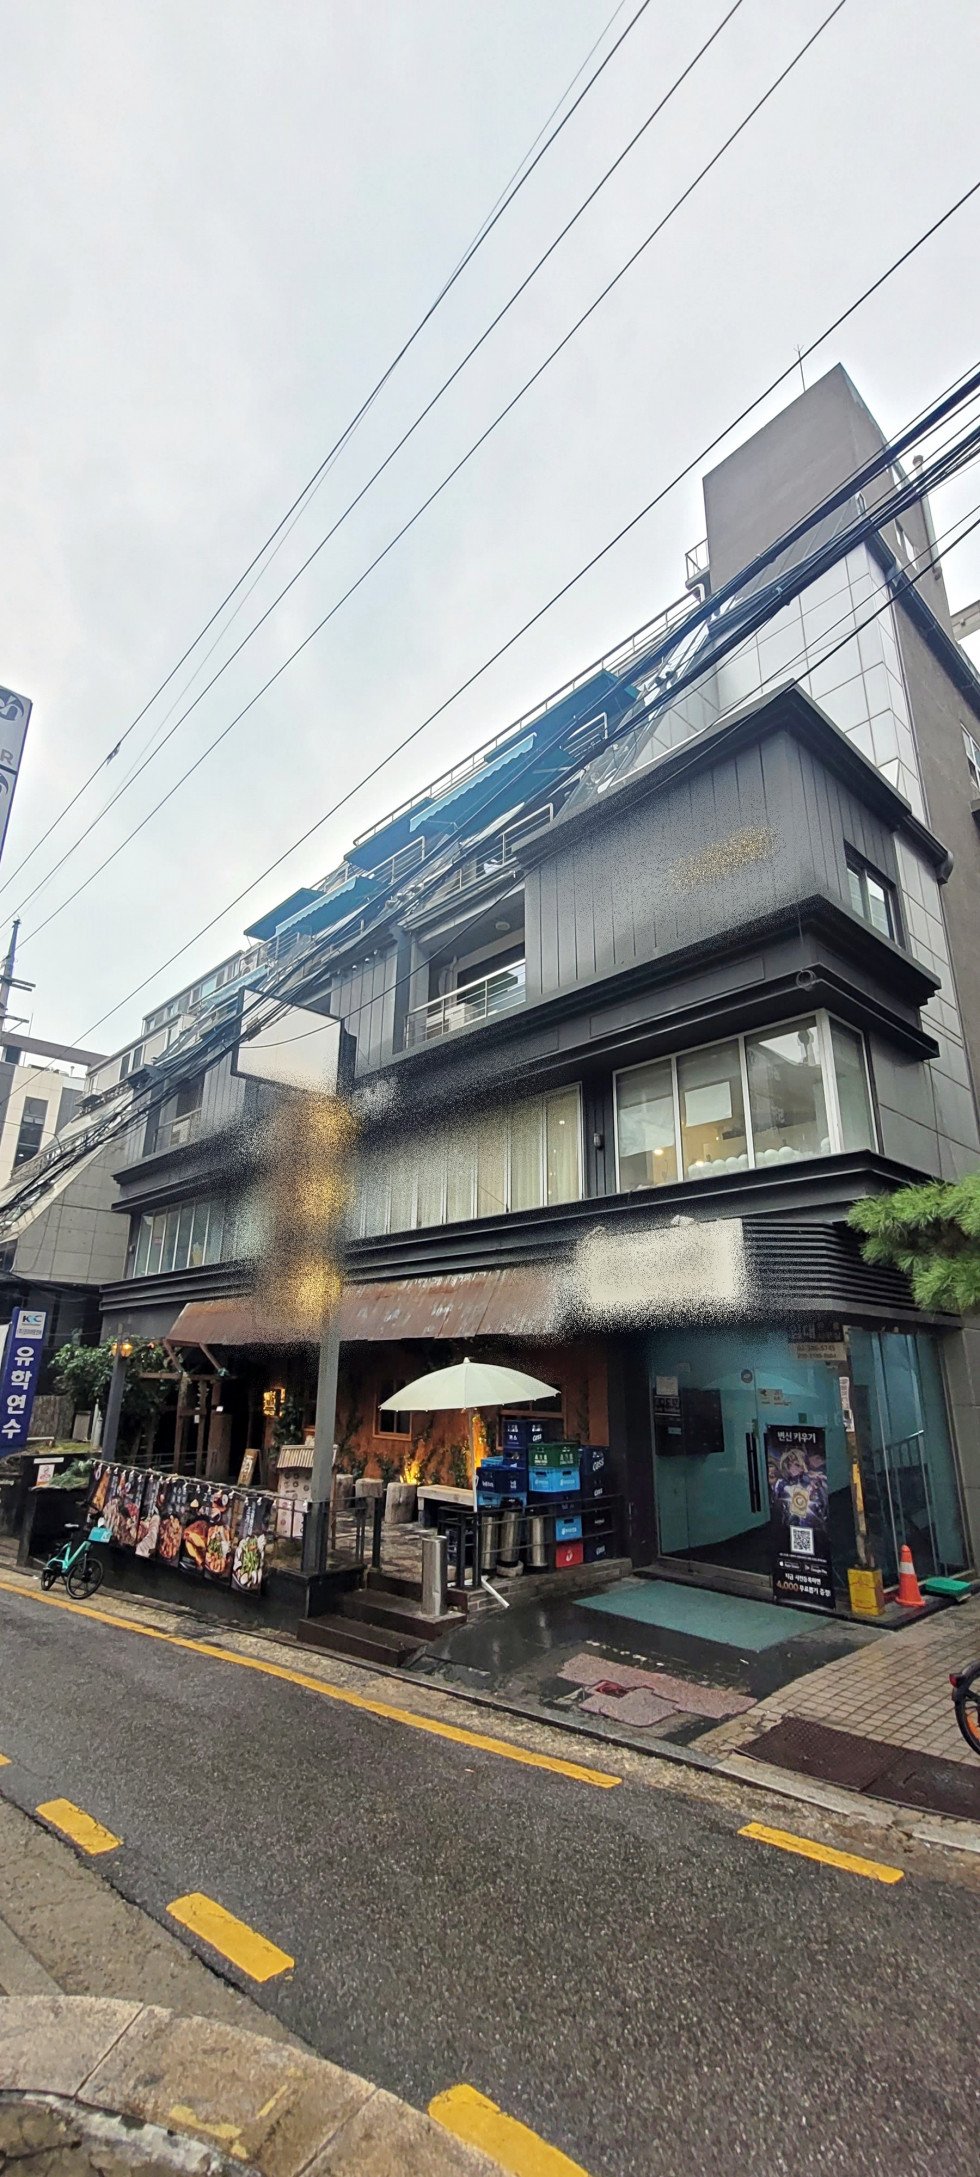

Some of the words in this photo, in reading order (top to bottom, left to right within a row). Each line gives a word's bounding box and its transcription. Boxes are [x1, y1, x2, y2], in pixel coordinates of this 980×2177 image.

[1, 1346, 35, 1439] 유학연수
[777, 1431, 793, 1442] 변신
[793, 1431, 816, 1444] 키우기
[776, 1580, 799, 1592] 4,000
